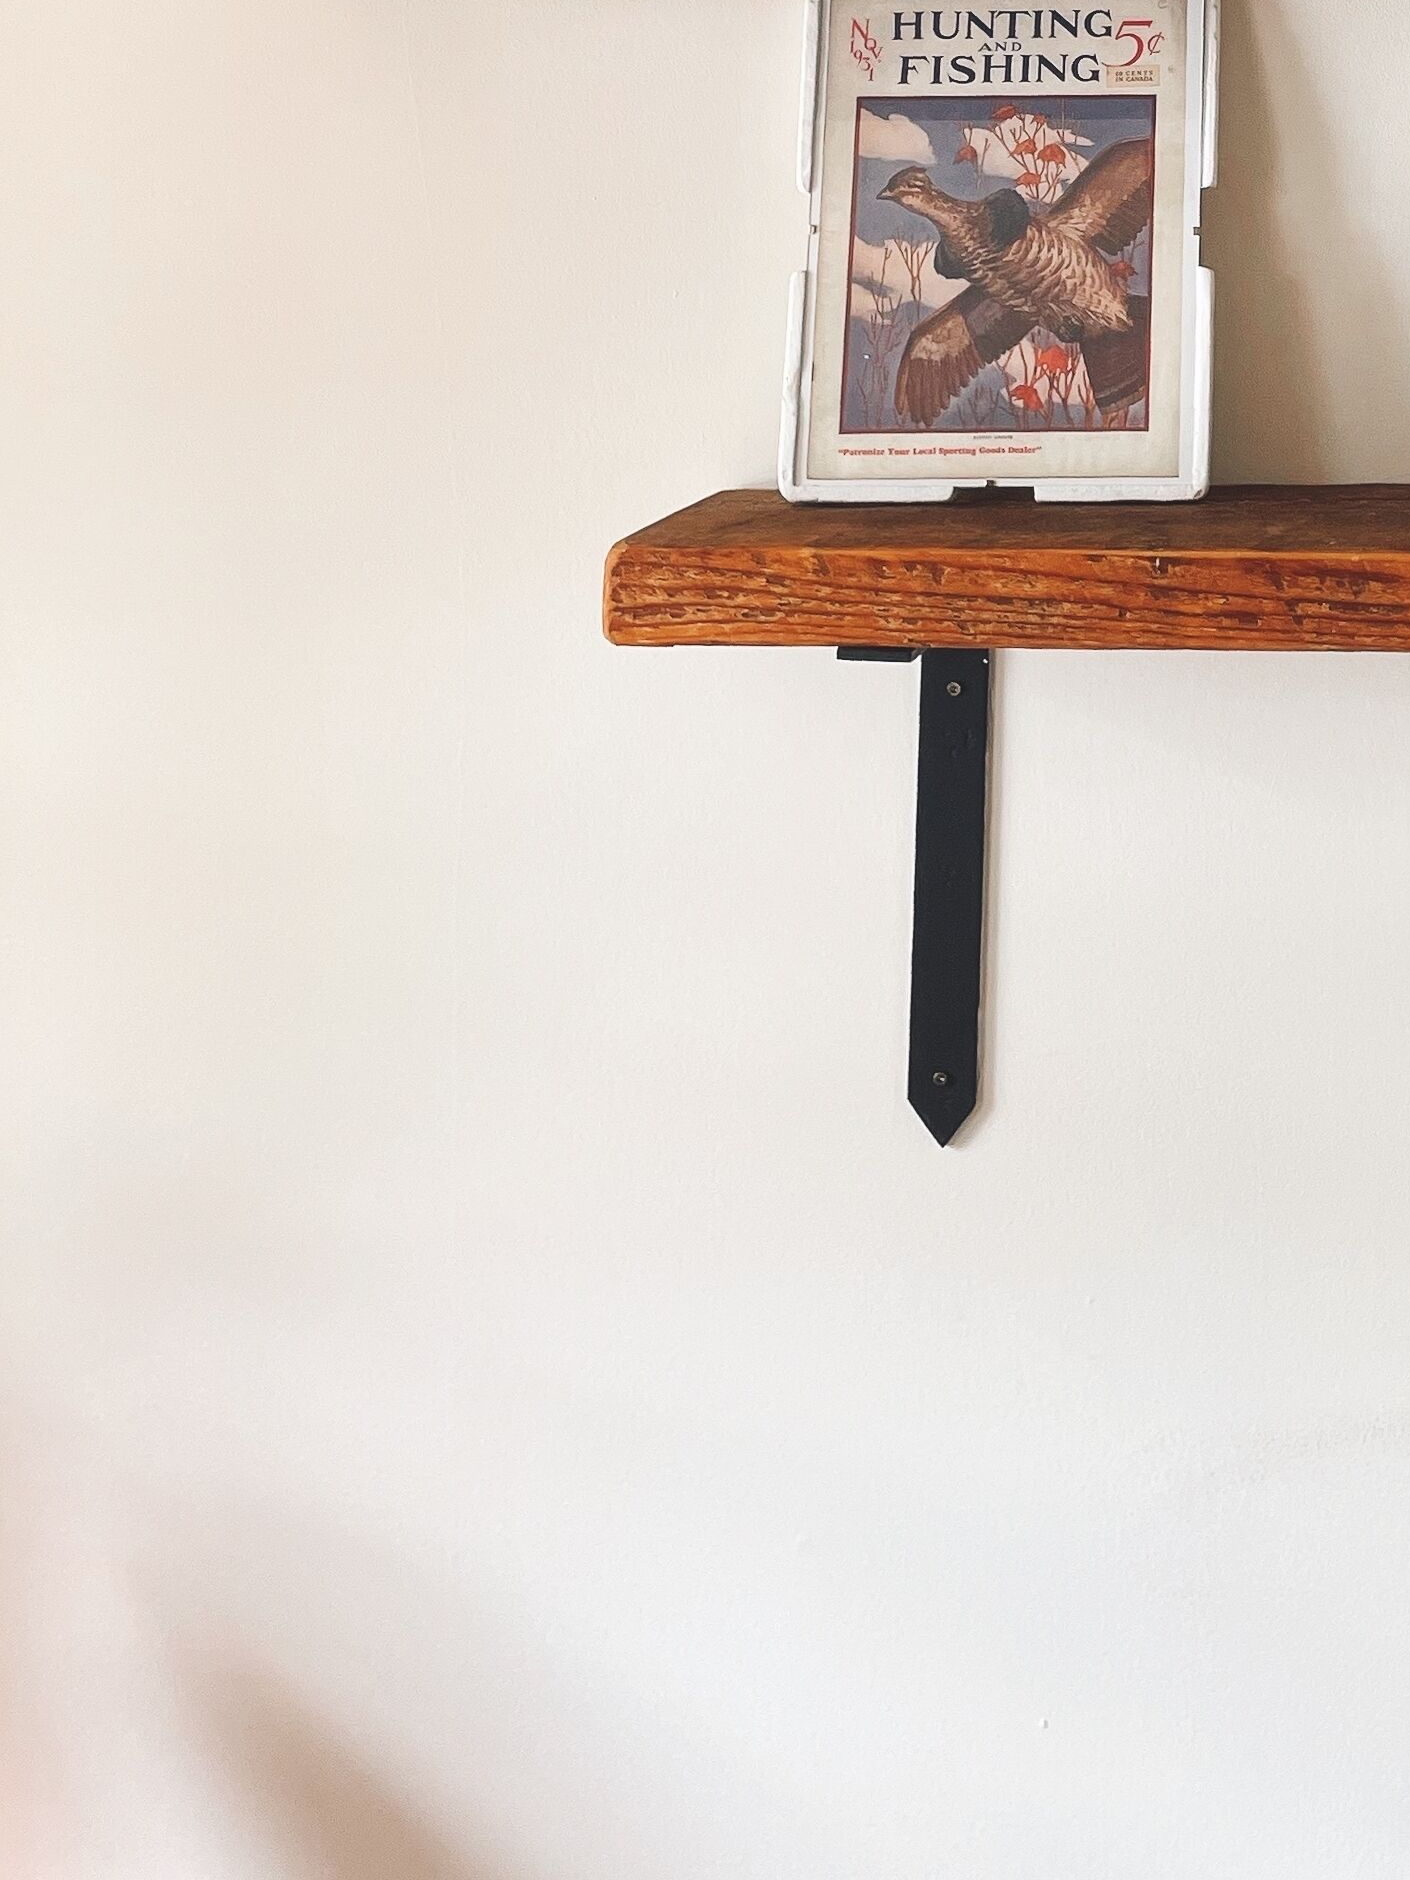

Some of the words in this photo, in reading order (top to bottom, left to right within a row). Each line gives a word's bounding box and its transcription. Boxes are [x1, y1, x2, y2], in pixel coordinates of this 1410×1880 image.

[891, 9, 1113, 41] HUNTING
[850, 40, 874, 81] 1931
[978, 41, 1022, 52] AND
[897, 53, 1101, 84] FISHING
[888, 448, 910, 456] Your
[913, 447, 936, 455] Local
[939, 447, 976, 456] Sporting
[979, 446, 1005, 454] Goods
